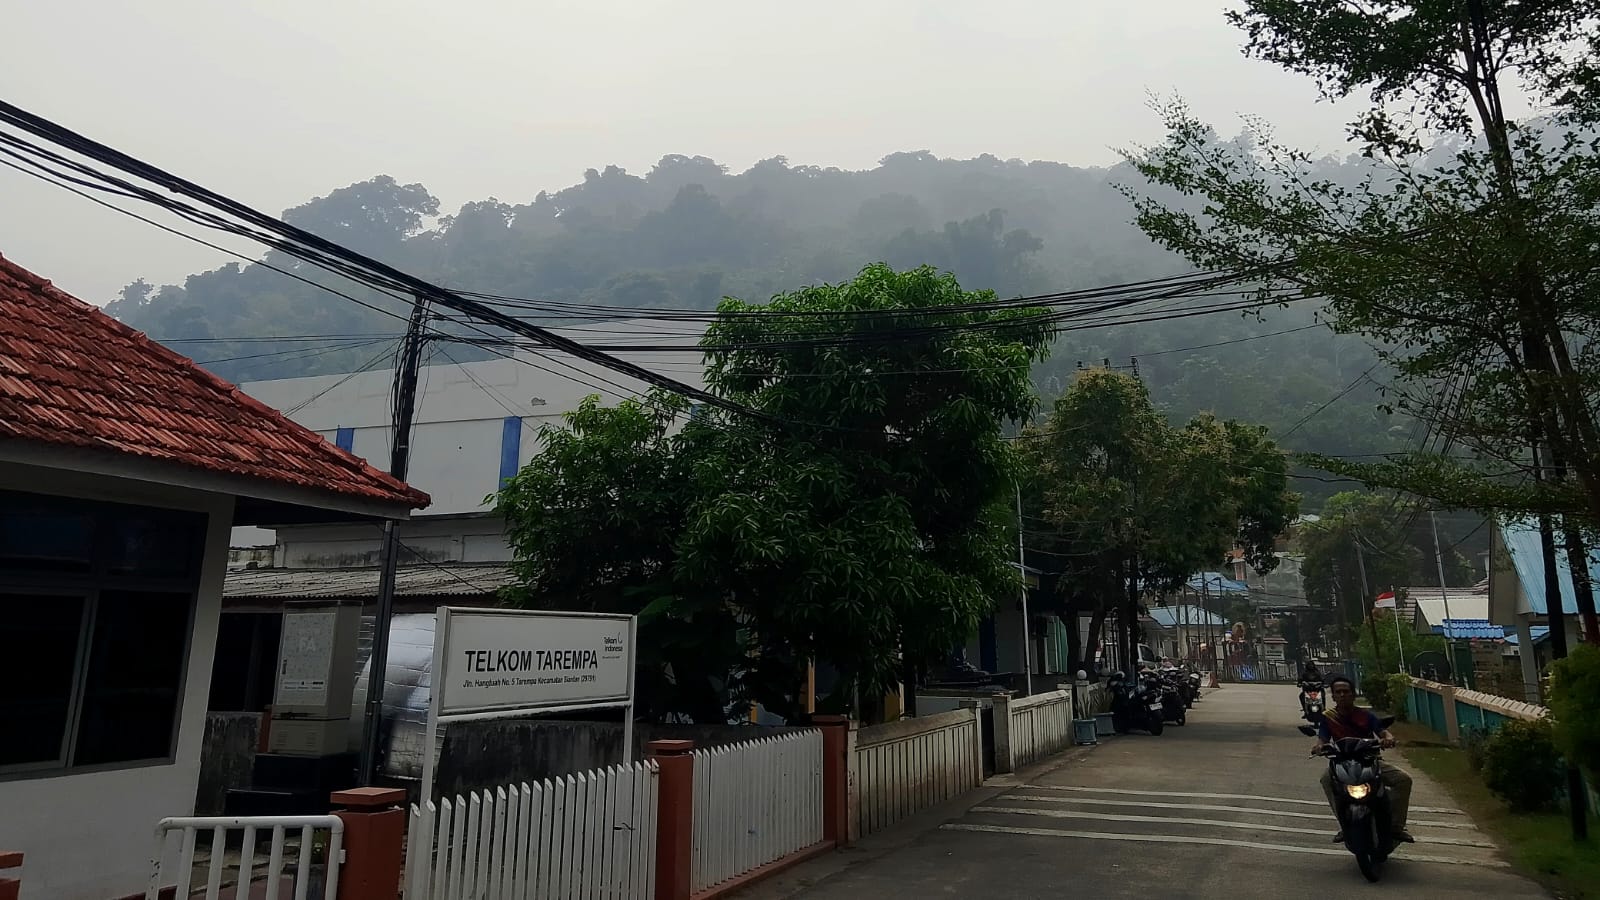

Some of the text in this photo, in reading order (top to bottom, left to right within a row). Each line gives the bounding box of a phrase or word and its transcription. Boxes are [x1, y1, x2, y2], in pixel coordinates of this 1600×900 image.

[465, 649, 598, 673] TELKOM TAREMPA
[502, 678, 510, 686] No.
